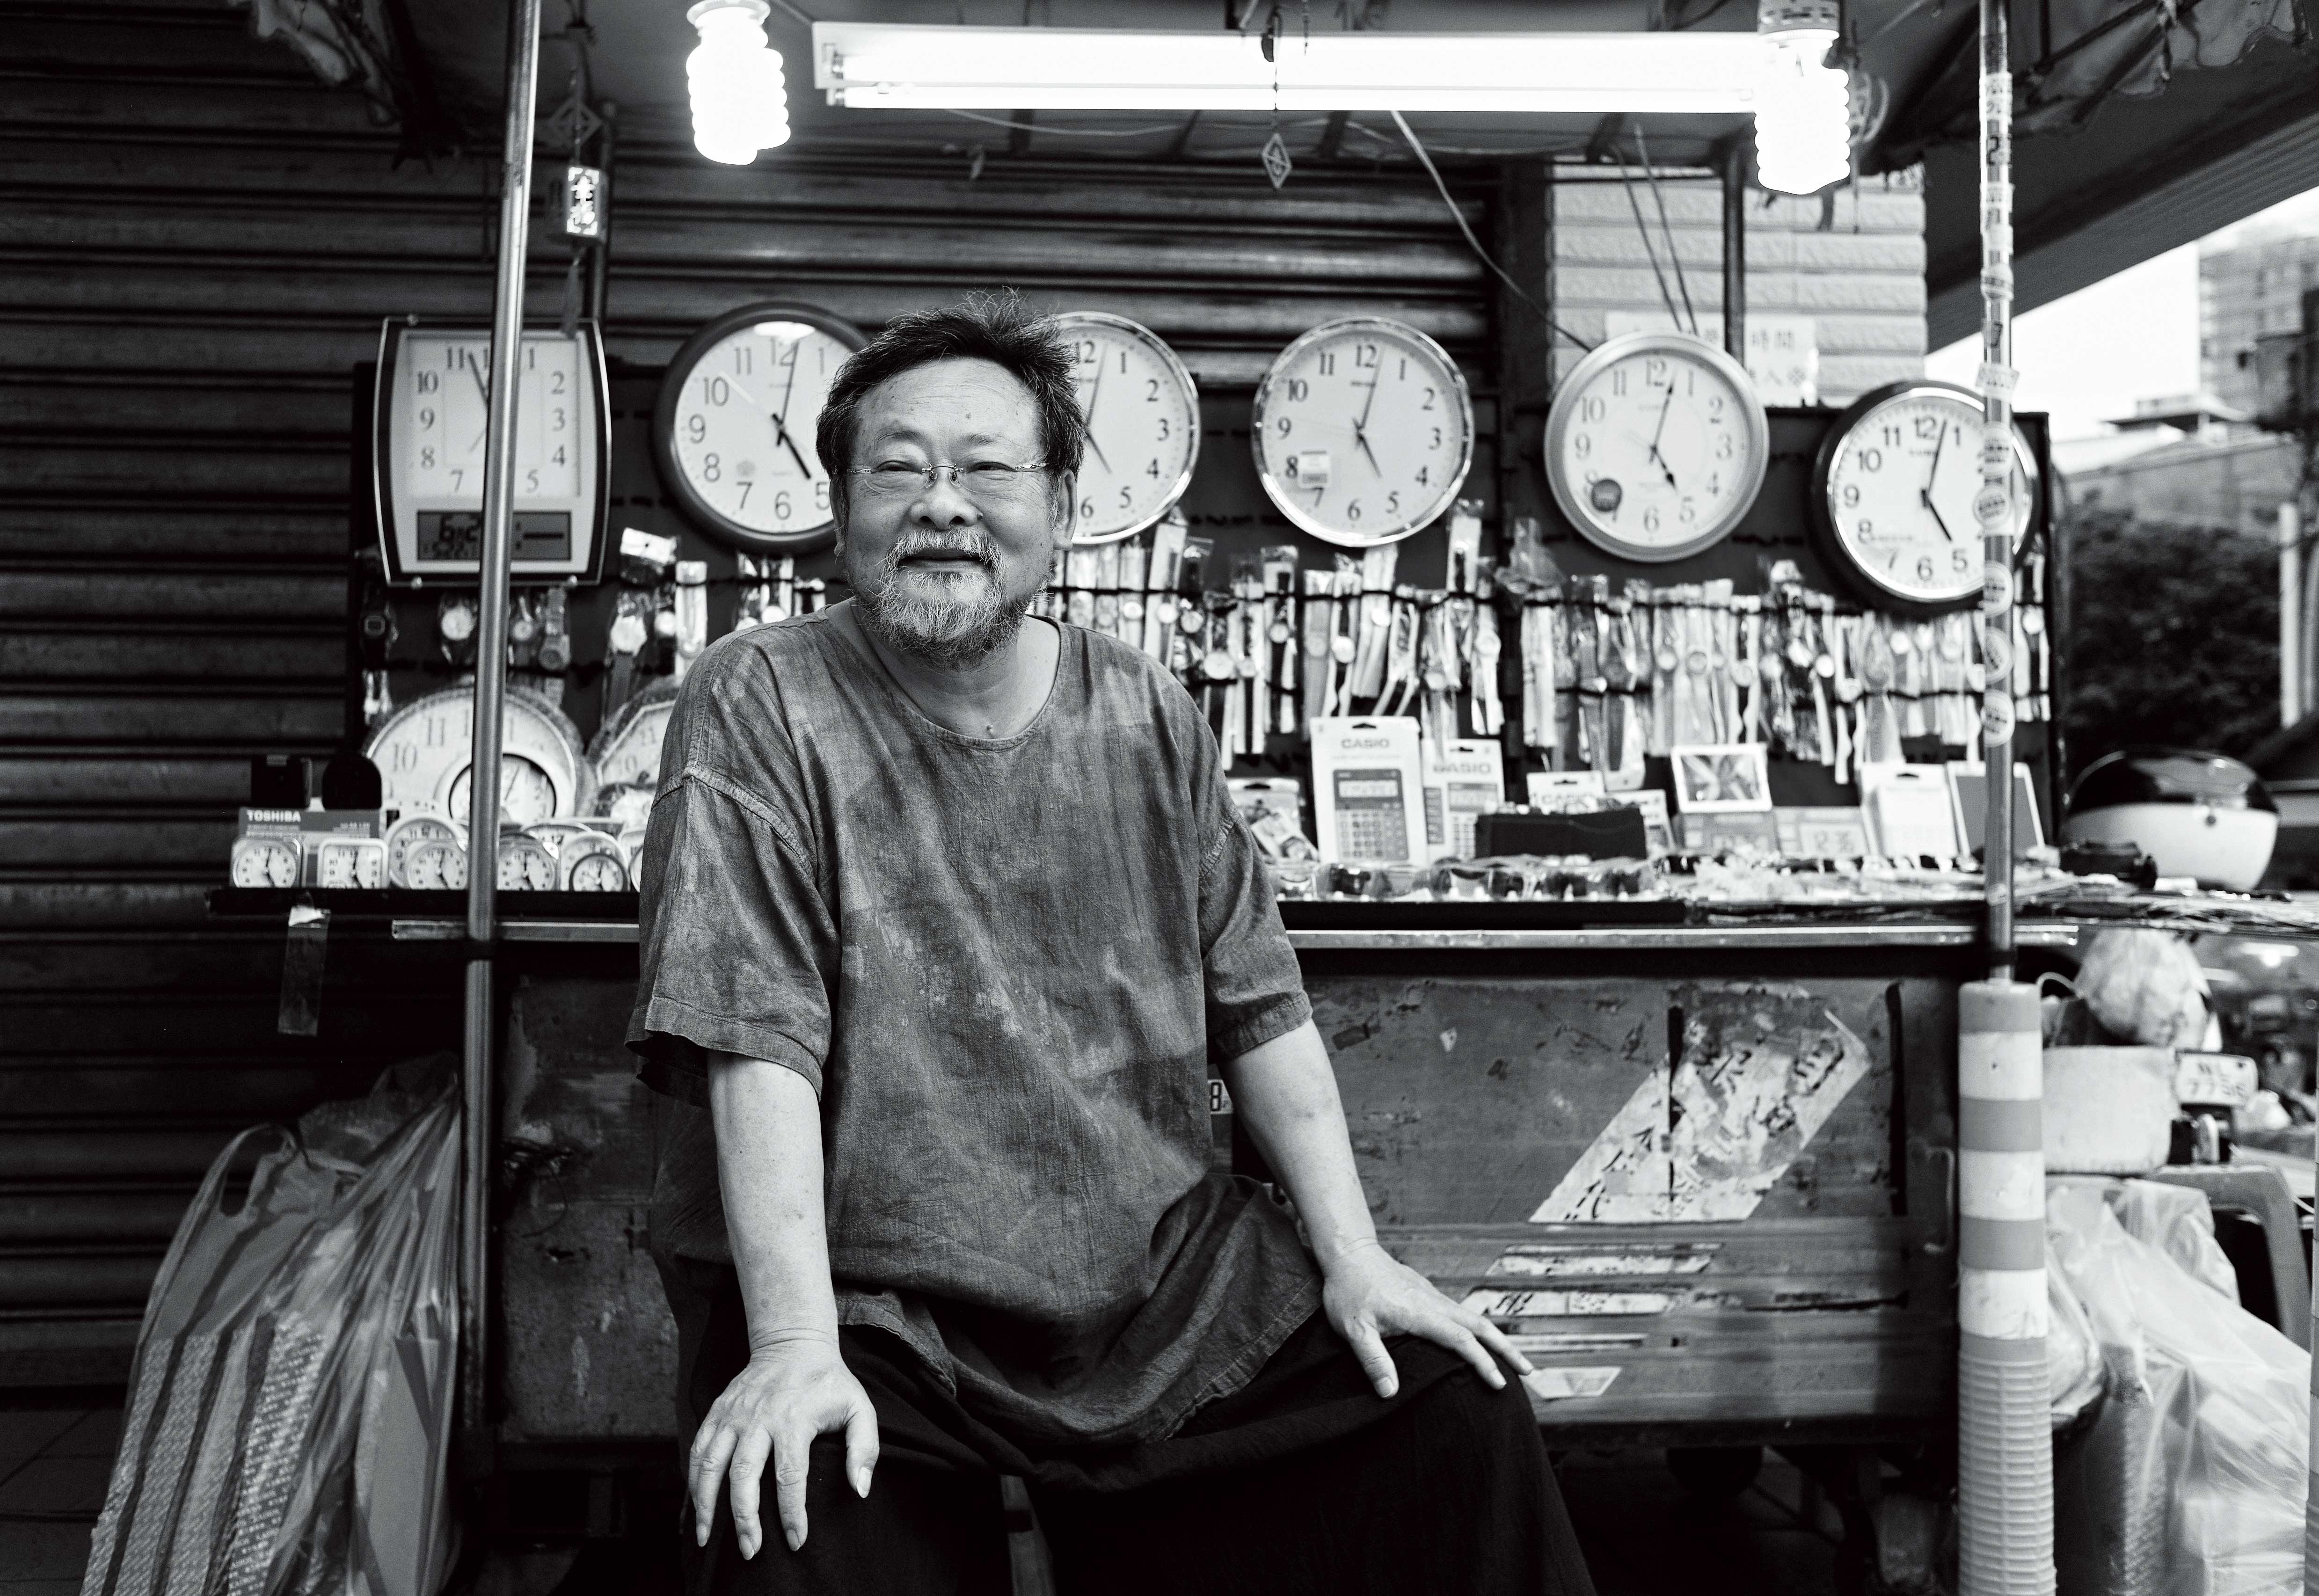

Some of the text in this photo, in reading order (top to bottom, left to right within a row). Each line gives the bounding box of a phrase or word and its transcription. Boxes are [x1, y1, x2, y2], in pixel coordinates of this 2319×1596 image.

[446, 347, 464, 370] 11
[529, 348, 535, 371] 1
[734, 347, 752, 375] 11
[770, 336, 795, 366] 12
[819, 347, 824, 374] 1
[1120, 352, 1126, 374] 1
[1356, 344, 1377, 368] 12
[1320, 353, 1334, 376] 11
[1400, 358, 1405, 381] 1
[1646, 358, 1667, 387] 12
[417, 370, 438, 394] 10
[551, 371, 565, 394] 2
[703, 377, 729, 406] 10
[1146, 379, 1159, 401] 2
[1289, 379, 1308, 402] 10
[1613, 370, 1626, 396] 11
[1688, 370, 1693, 397] 1
[1422, 387, 1435, 411] 2
[1582, 396, 1605, 423] 10
[1708, 395, 1723, 424] 2
[420, 407, 435, 431] 9
[552, 408, 566, 431] 3
[689, 414, 706, 444] 9
[1156, 418, 1169, 441] 3
[1278, 418, 1291, 440] 9
[1915, 416, 1937, 439] 12
[1428, 427, 1441, 450] 3
[1575, 433, 1590, 460] 9
[1716, 433, 1732, 460] 3
[1883, 426, 1900, 446] 11
[1954, 426, 1960, 446] 1
[421, 445, 435, 470] 8
[551, 445, 566, 467] 4
[704, 453, 721, 482] 8
[1286, 456, 1298, 479] 8
[1857, 448, 1881, 472] 10
[1146, 458, 1159, 479] 4
[1415, 466, 1428, 488] 4
[450, 470, 464, 492] 7
[526, 469, 539, 493] 5
[1706, 472, 1719, 496] 4
[737, 481, 752, 509] 7
[775, 491, 791, 520] 6
[815, 481, 830, 510] 5
[1080, 495, 1094, 518] 6
[1119, 486, 1131, 509] 5
[1312, 487, 1324, 508] 7
[1386, 490, 1399, 513] 5
[1845, 485, 1860, 508] 9
[1348, 498, 1361, 521] 6
[1643, 505, 1660, 532] 6
[1679, 496, 1695, 523] 5
[1858, 519, 1872, 543] 8
[1918, 556, 1932, 581] 6
[1952, 548, 1968, 573] 5
[427, 717, 445, 746] 11
[1341, 738, 1390, 749] CASIO
[394, 742, 416, 772] 10
[1433, 763, 1491, 774] ASIO
[247, 810, 301, 822] TOSHIBA
